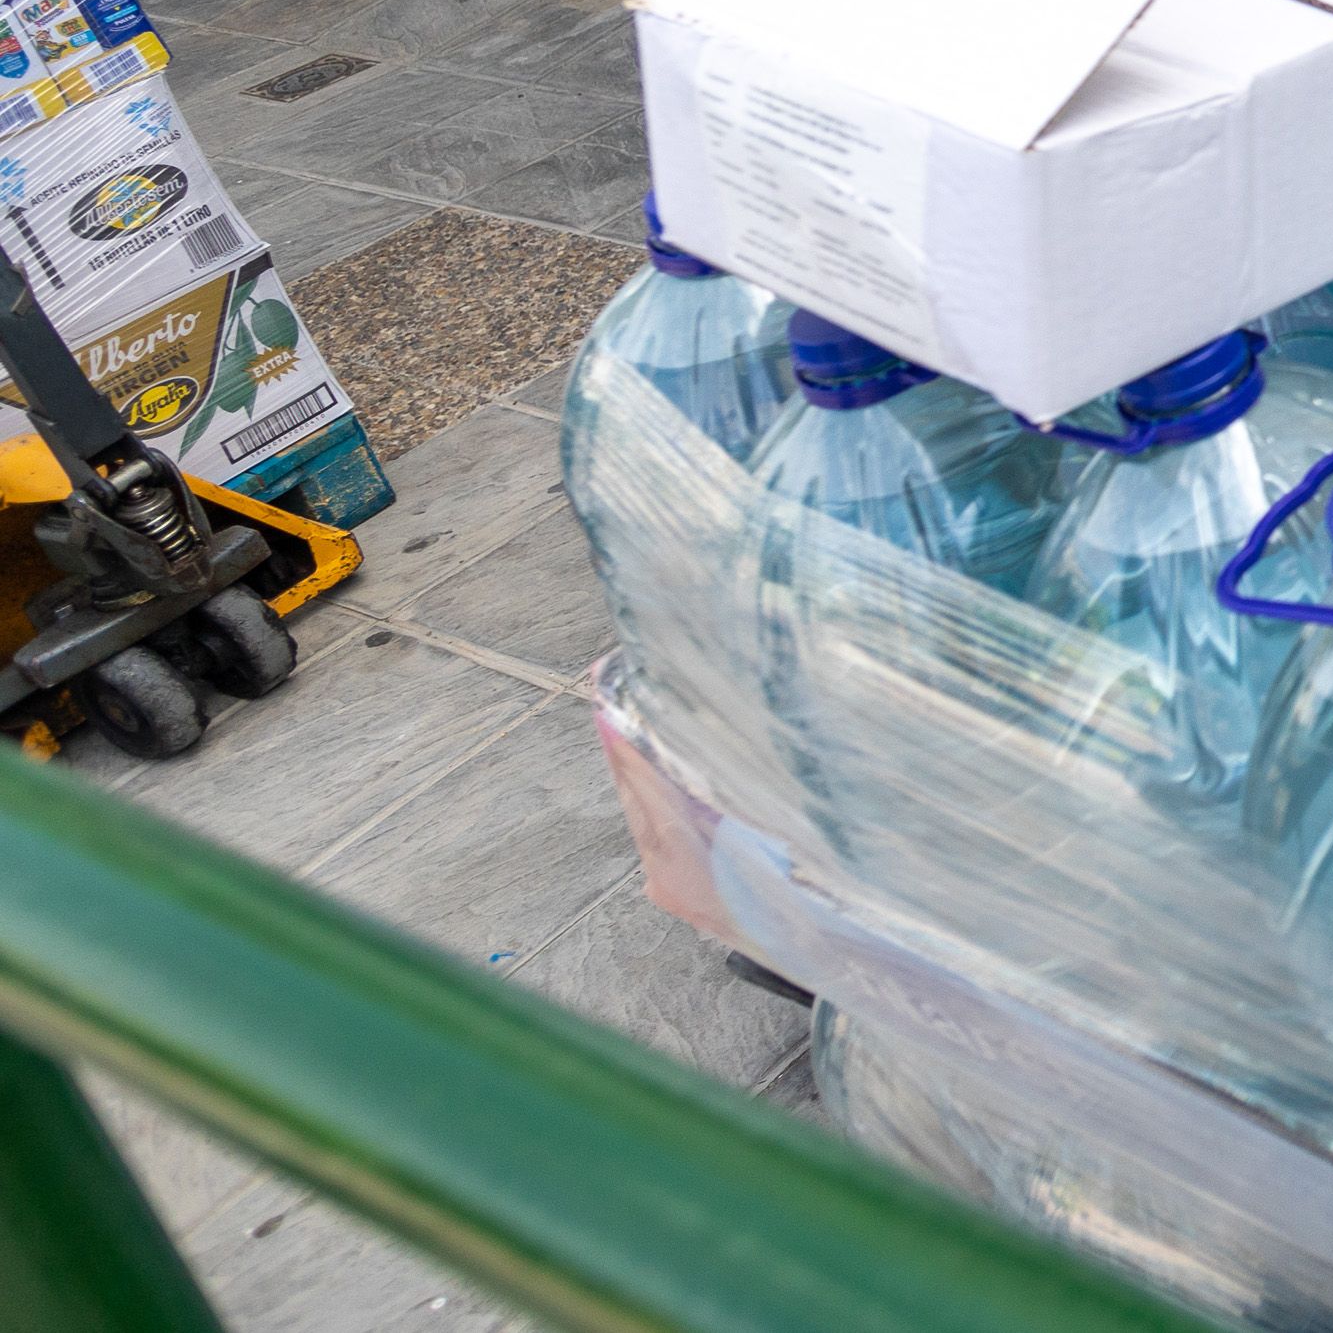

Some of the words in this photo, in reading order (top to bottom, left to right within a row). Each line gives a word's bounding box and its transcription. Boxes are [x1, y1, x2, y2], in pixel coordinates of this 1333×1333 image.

[30, 182, 69, 208] ACEITE
[184, 204, 212, 227] LITRO
[253, 351, 292, 378] EXTRA
